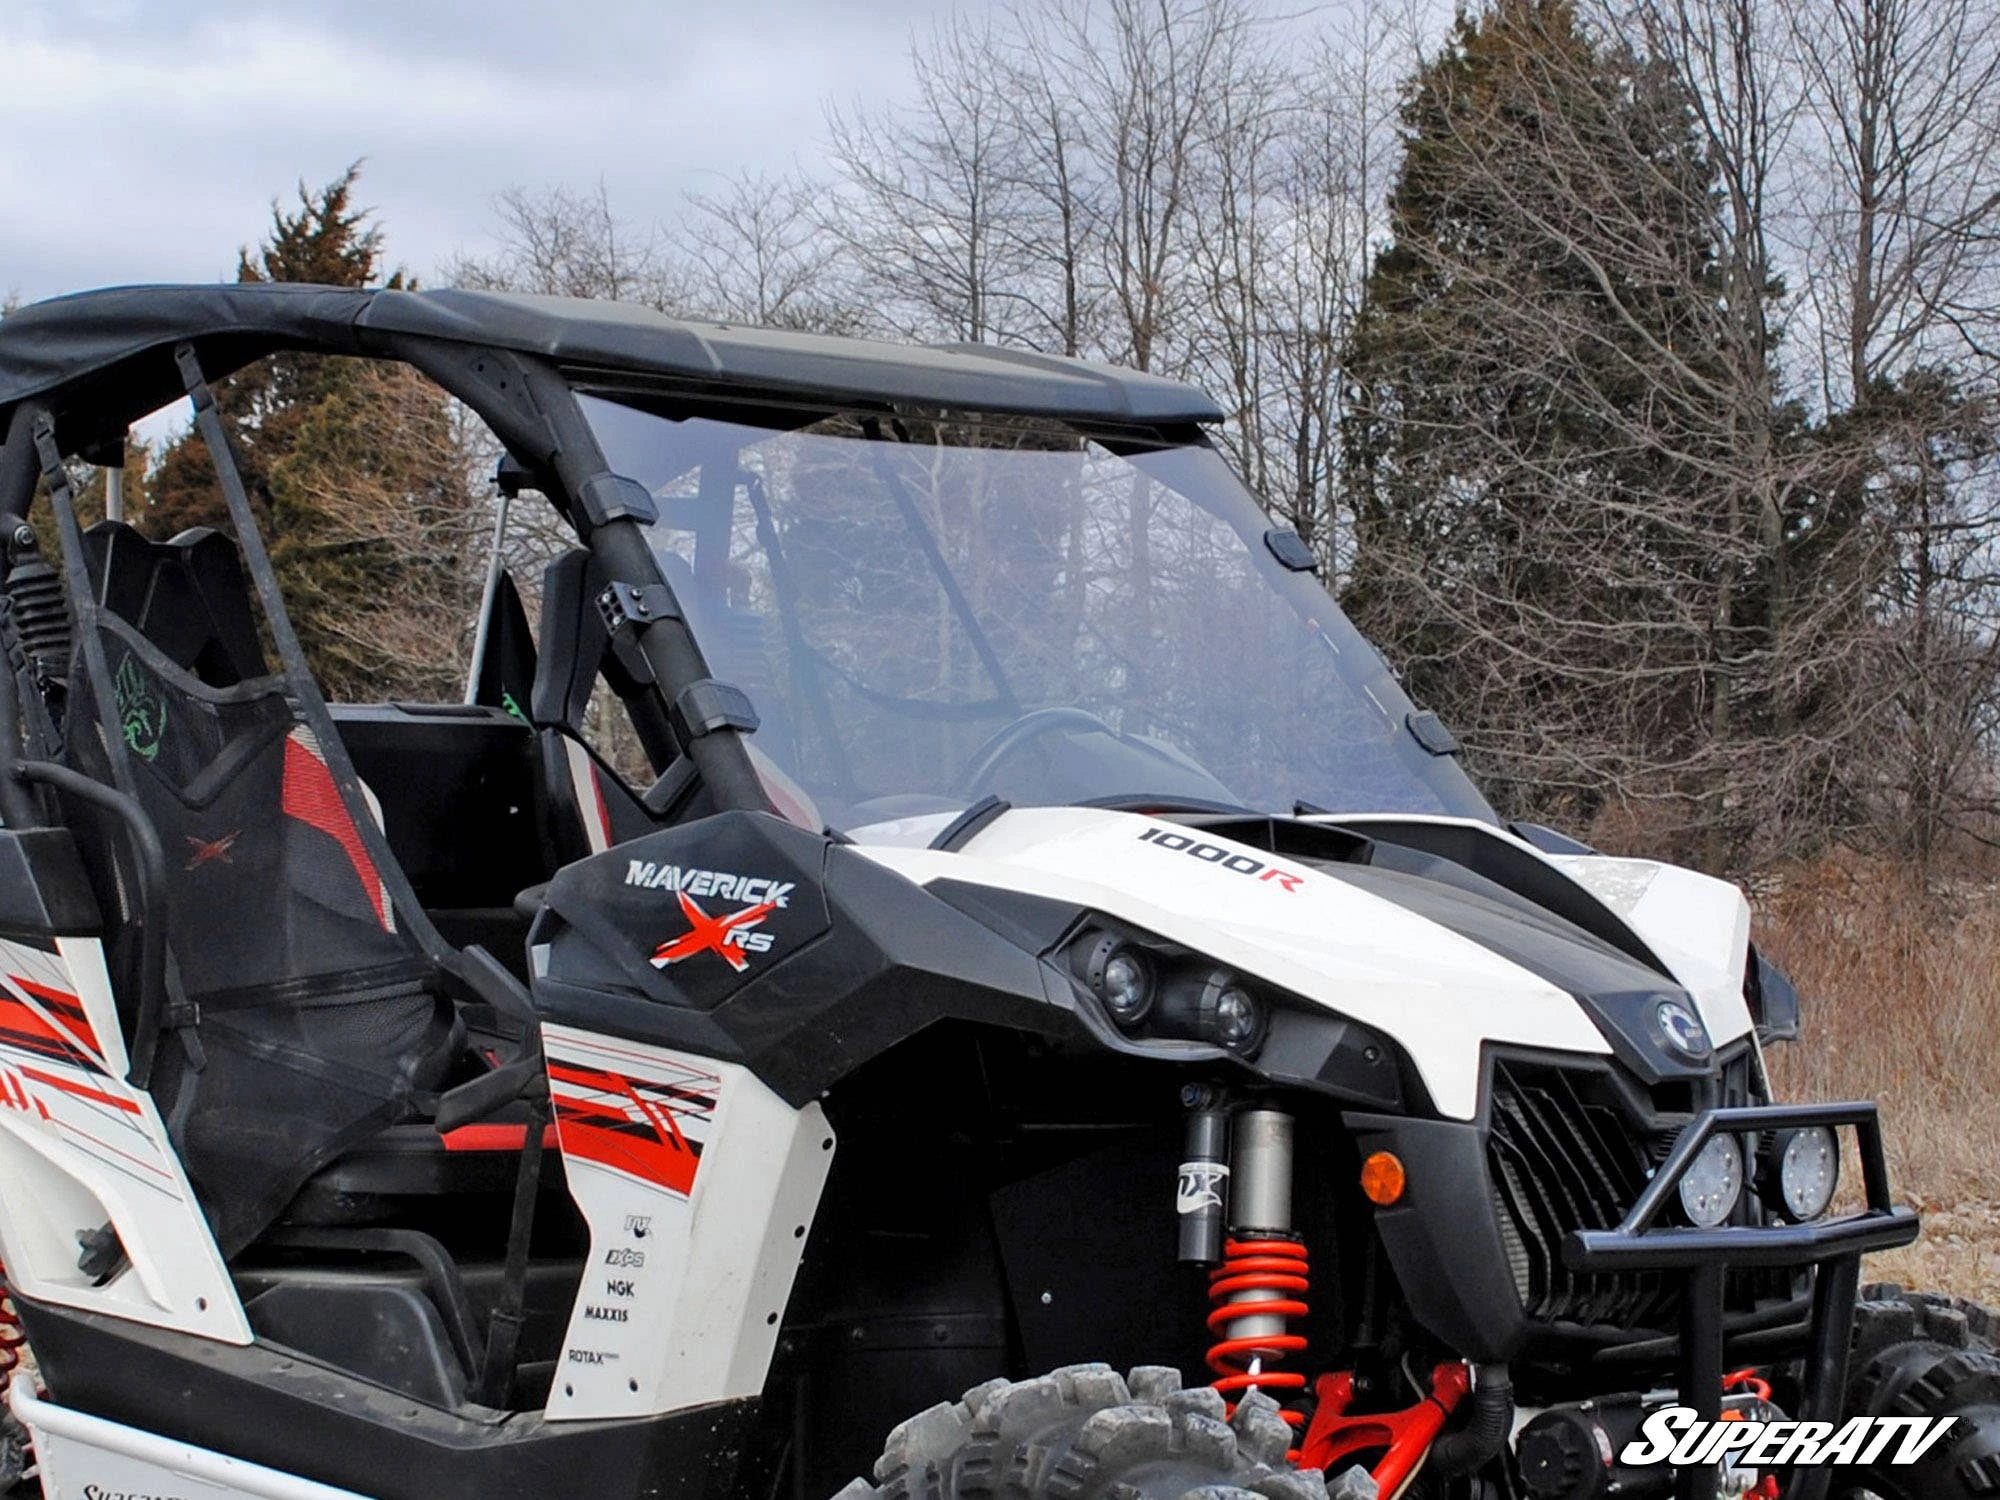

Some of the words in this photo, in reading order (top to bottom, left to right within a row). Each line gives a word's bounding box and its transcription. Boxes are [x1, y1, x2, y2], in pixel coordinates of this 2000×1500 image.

[1138, 828, 1305, 893] 1000R
[624, 860, 796, 907] MAVERICK
[606, 1280, 635, 1297] NGK
[584, 1305, 629, 1322] MAXXIS
[569, 1349, 604, 1365] ROTAX
